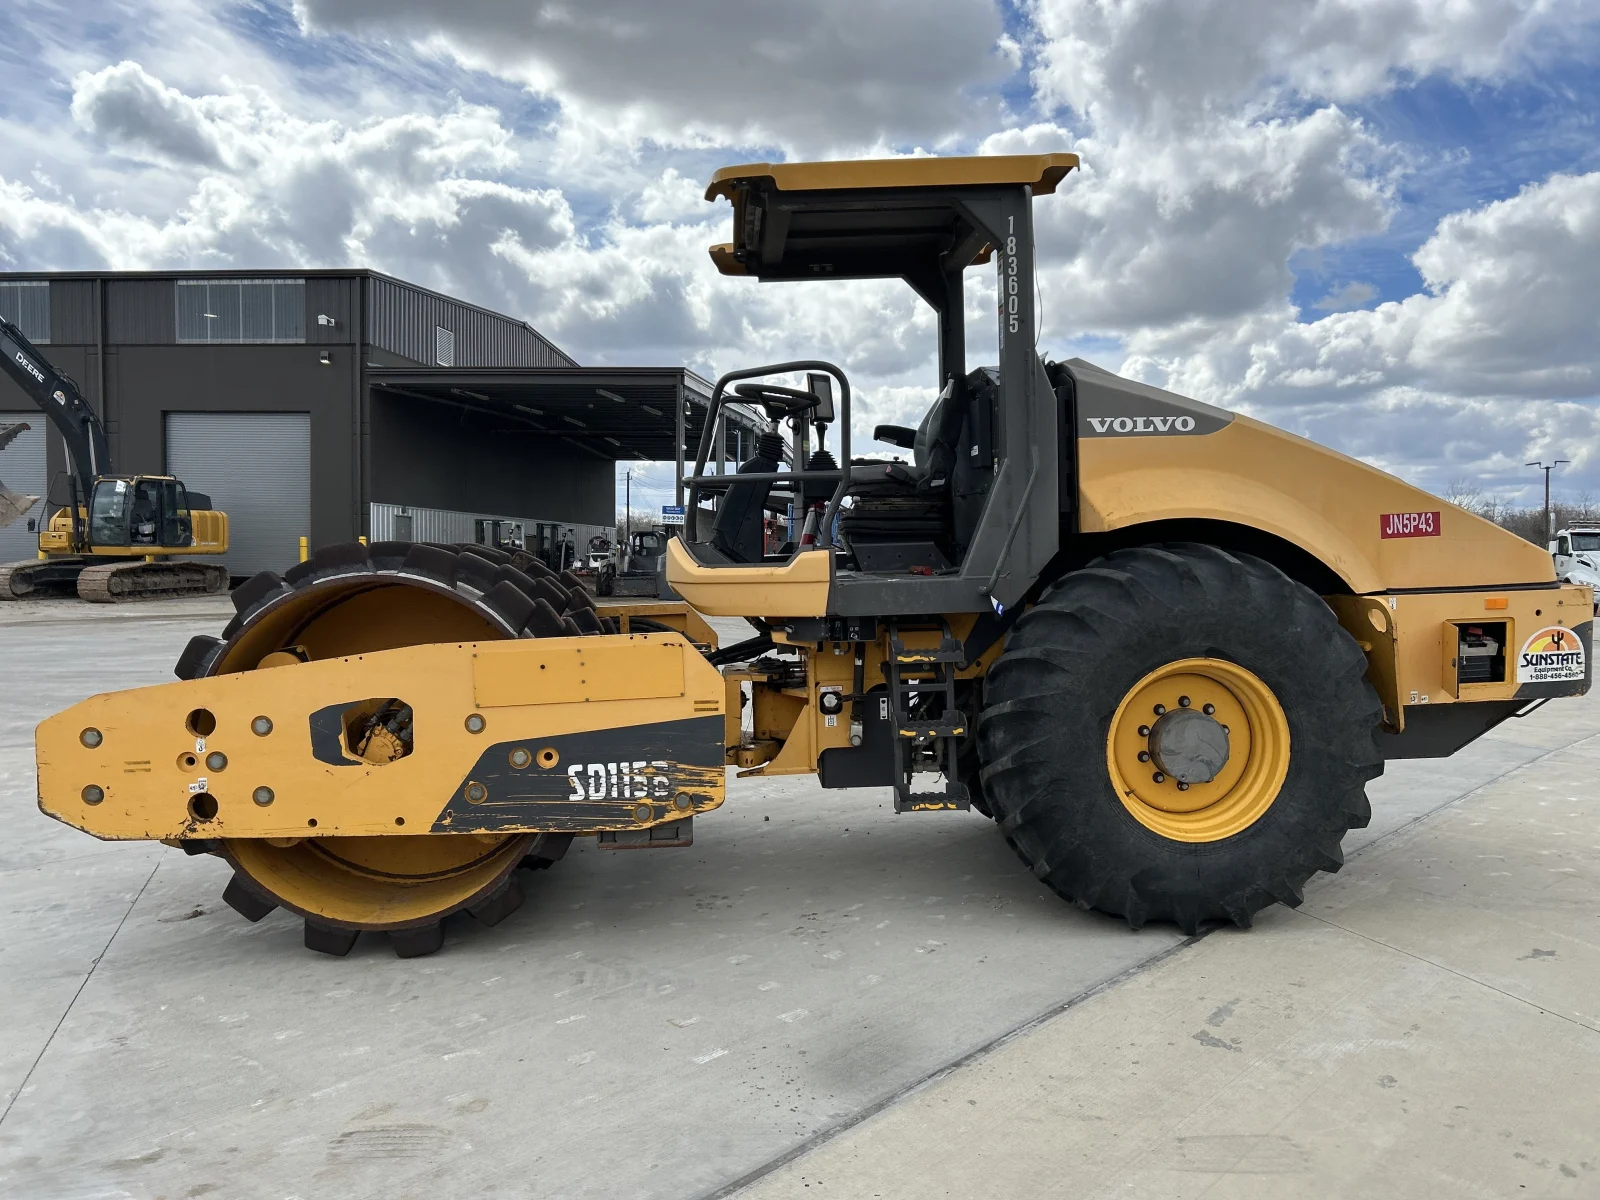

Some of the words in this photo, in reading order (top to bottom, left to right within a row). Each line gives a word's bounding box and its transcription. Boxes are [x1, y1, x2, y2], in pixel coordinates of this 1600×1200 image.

[1007, 215, 1019, 333] 183605
[15, 351, 45, 383] DEERE
[1086, 416, 1196, 433] VOLVO
[1386, 512, 1434, 535] JN5P43
[1520, 652, 1583, 668] SUNSTATE
